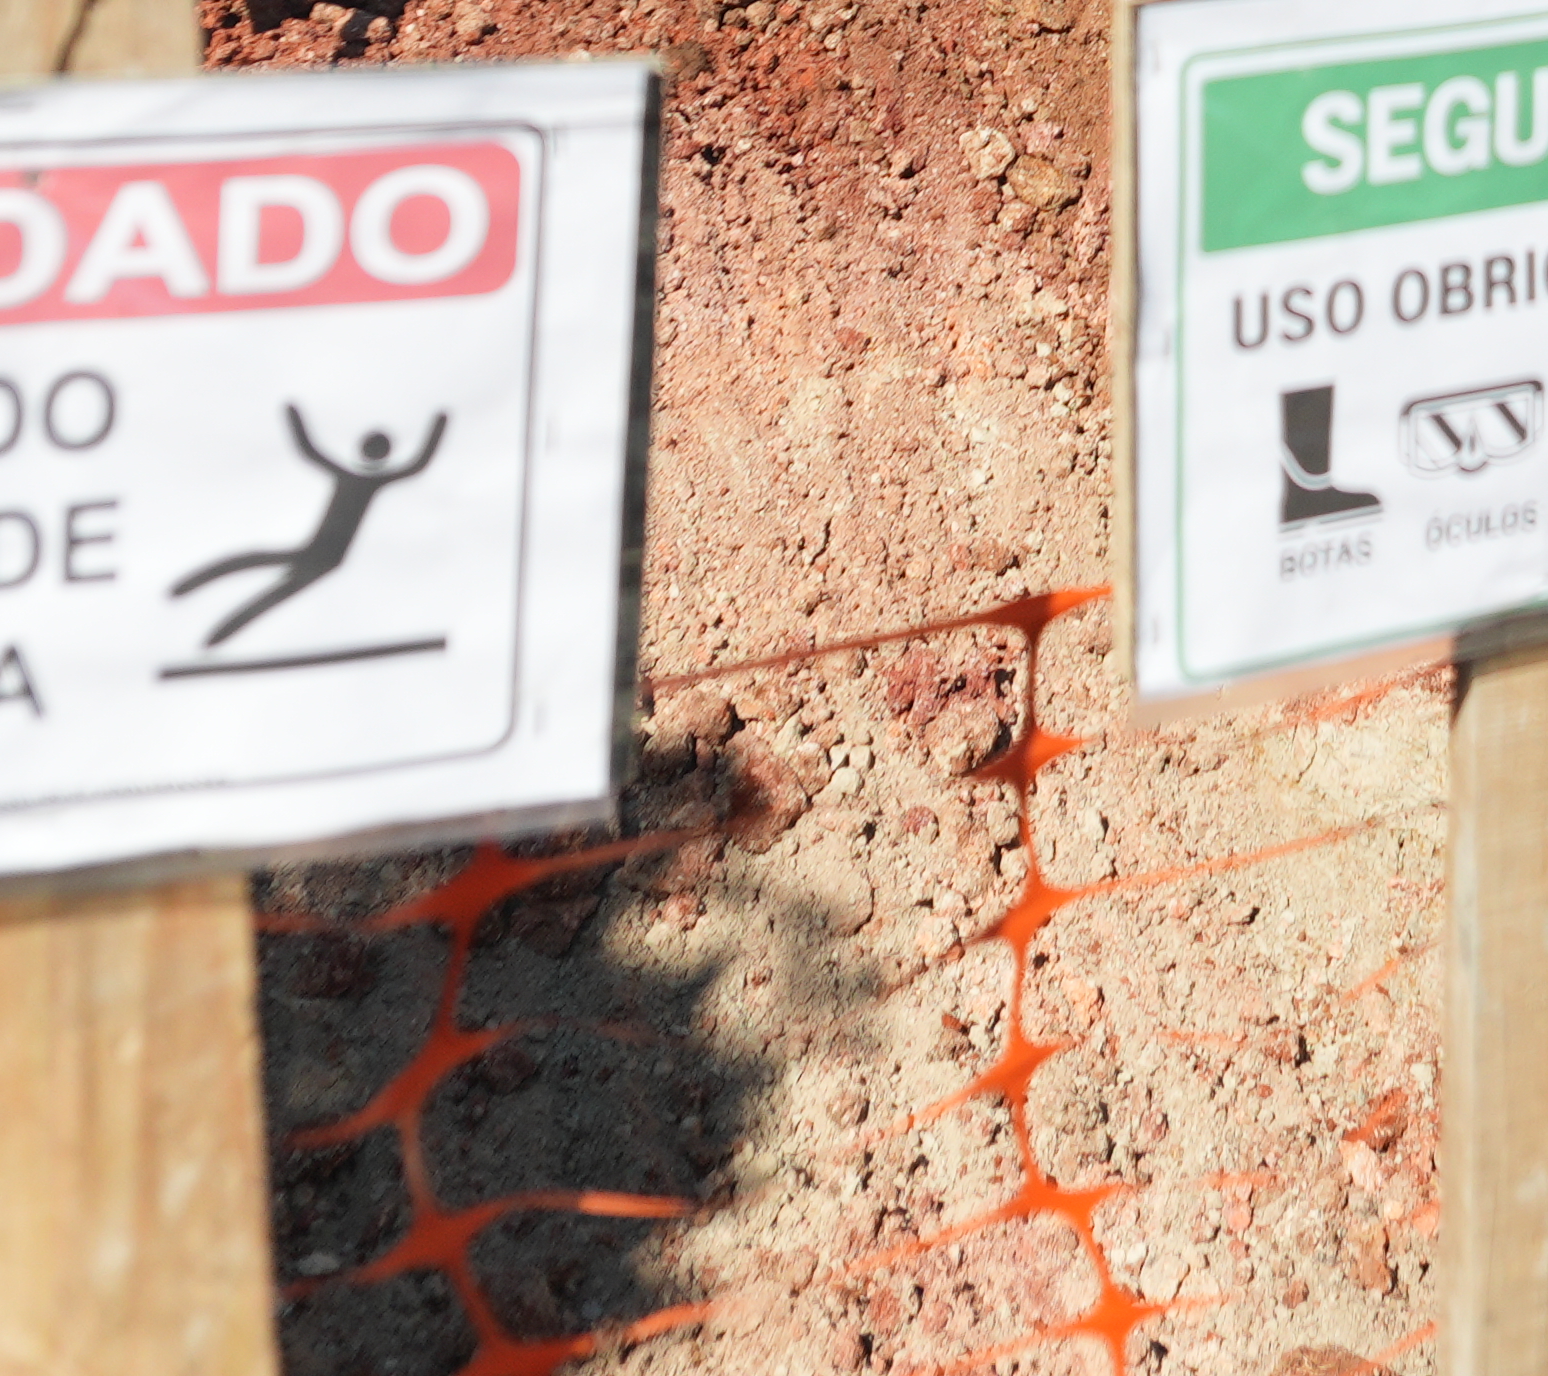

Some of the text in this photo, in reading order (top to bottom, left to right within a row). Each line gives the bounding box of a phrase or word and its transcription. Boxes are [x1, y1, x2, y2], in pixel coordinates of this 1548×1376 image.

[1231, 278, 1365, 351] USO
[1424, 499, 1538, 548] ÓCULOS
[1278, 534, 1373, 580] BOTAS
